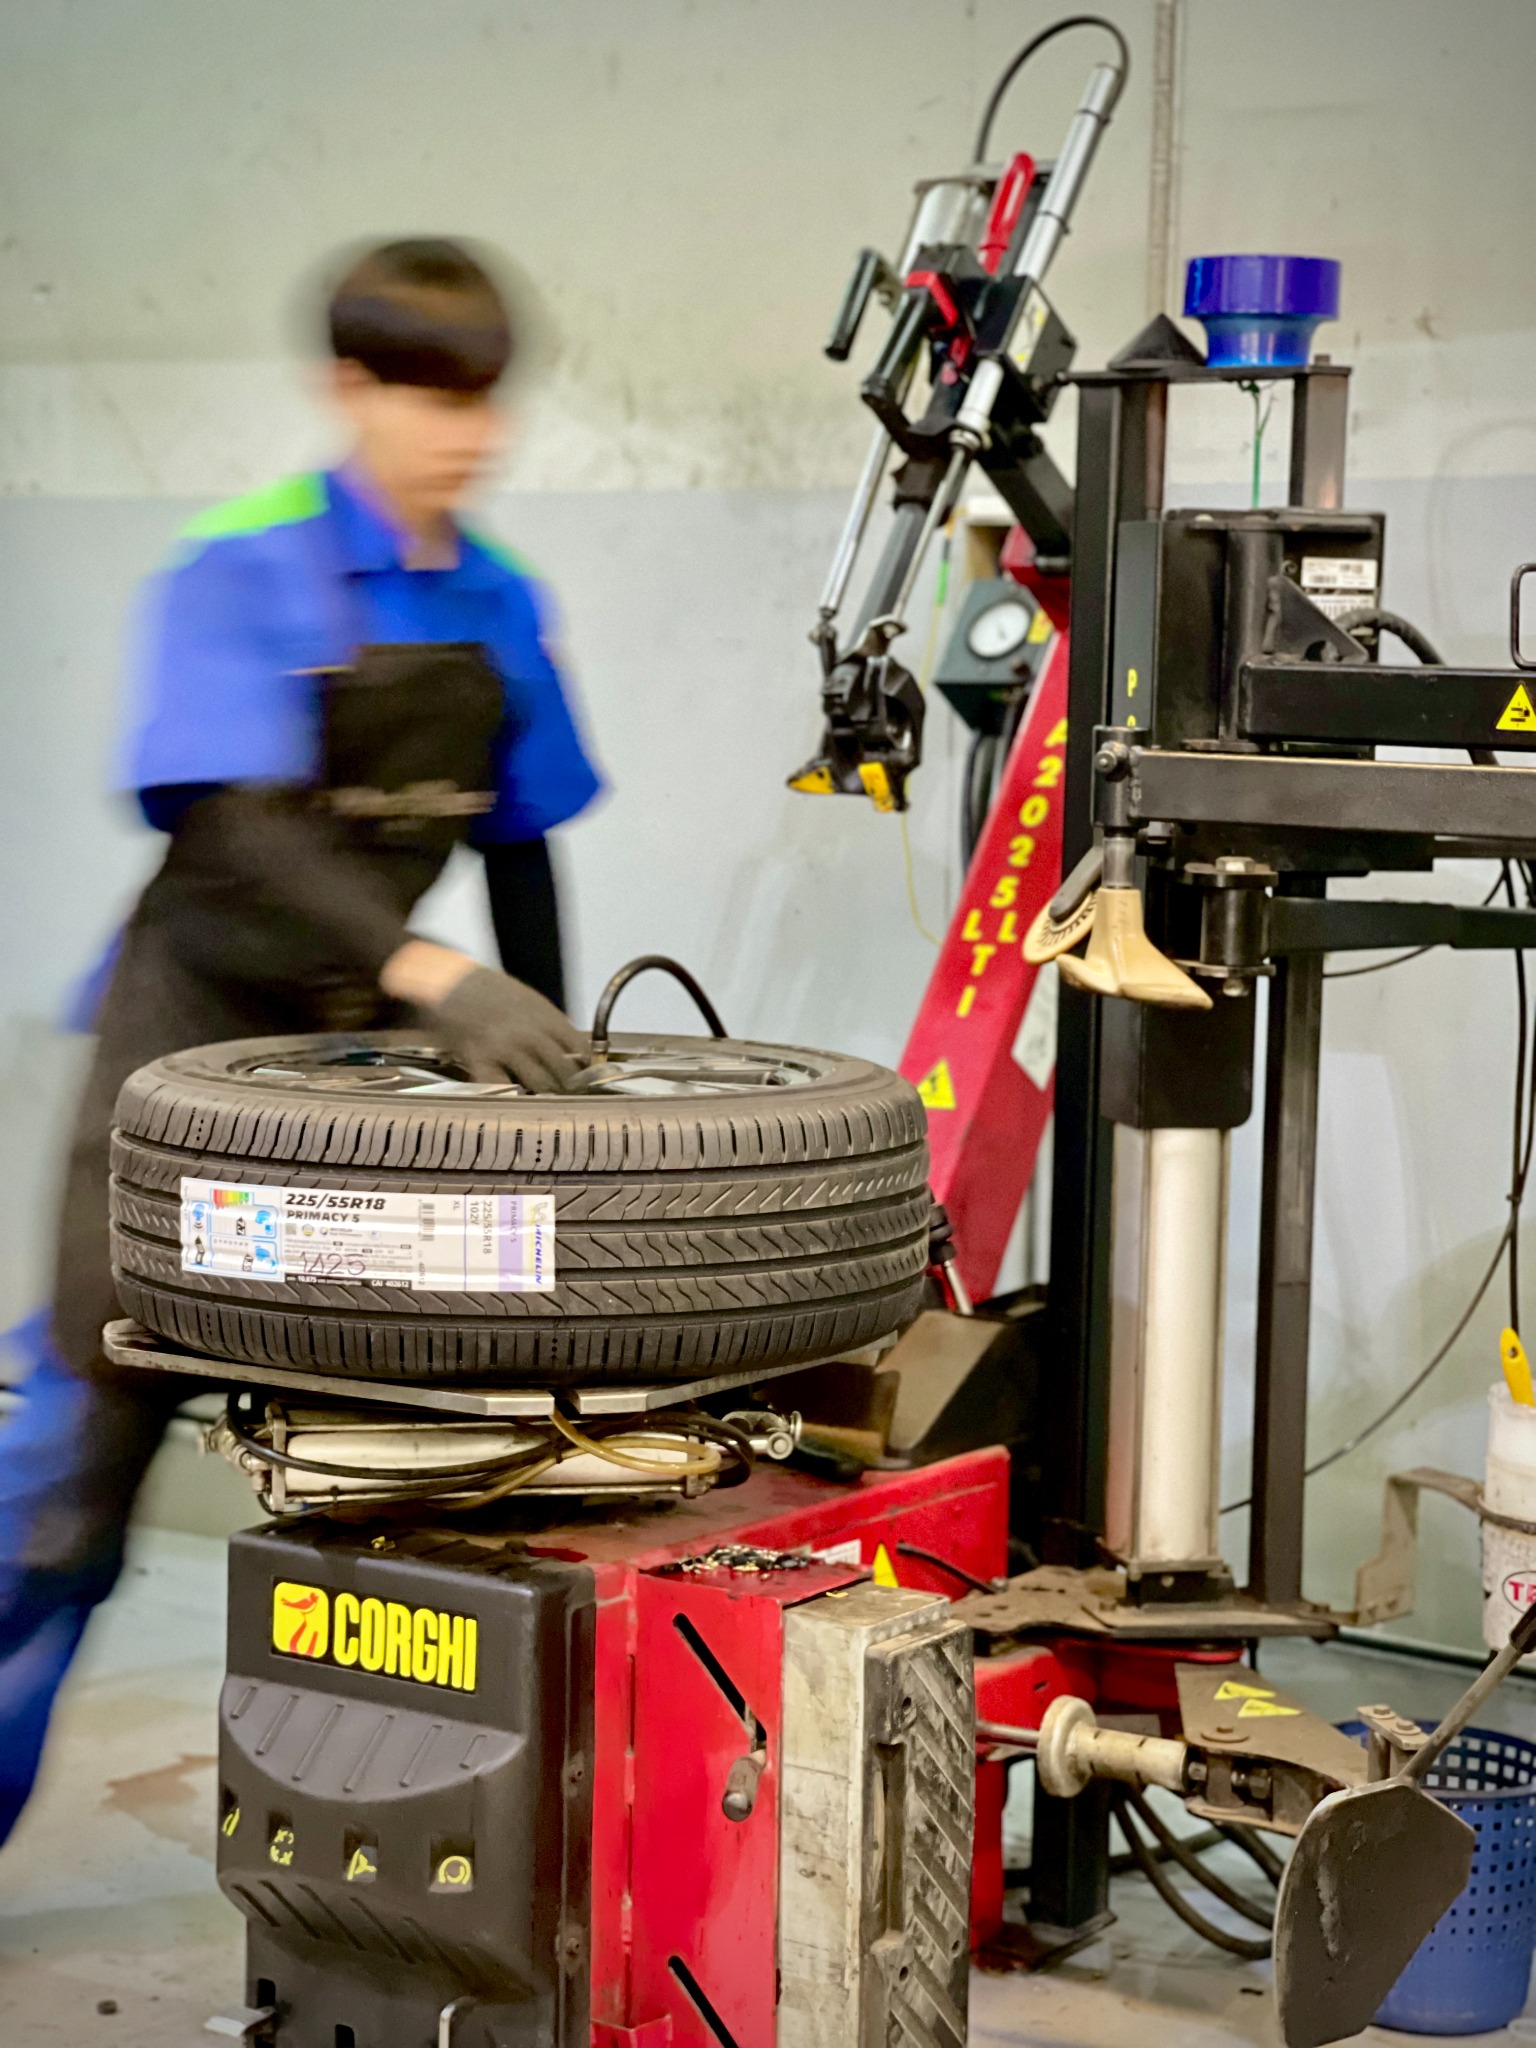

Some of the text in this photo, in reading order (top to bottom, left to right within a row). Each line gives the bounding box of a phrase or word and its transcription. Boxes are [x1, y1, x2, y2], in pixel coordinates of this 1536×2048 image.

[285, 1193, 387, 1210] 225/55R18
[286, 1209, 348, 1223] PRIMACY
[453, 1200, 460, 1211] XL
[470, 1201, 480, 1226] 102V
[482, 1200, 492, 1255] 225/55R18
[510, 1201, 518, 1236] PRIMACY
[535, 1223, 543, 1285] MICHELIN
[333, 1592, 478, 1691] CORGHI
